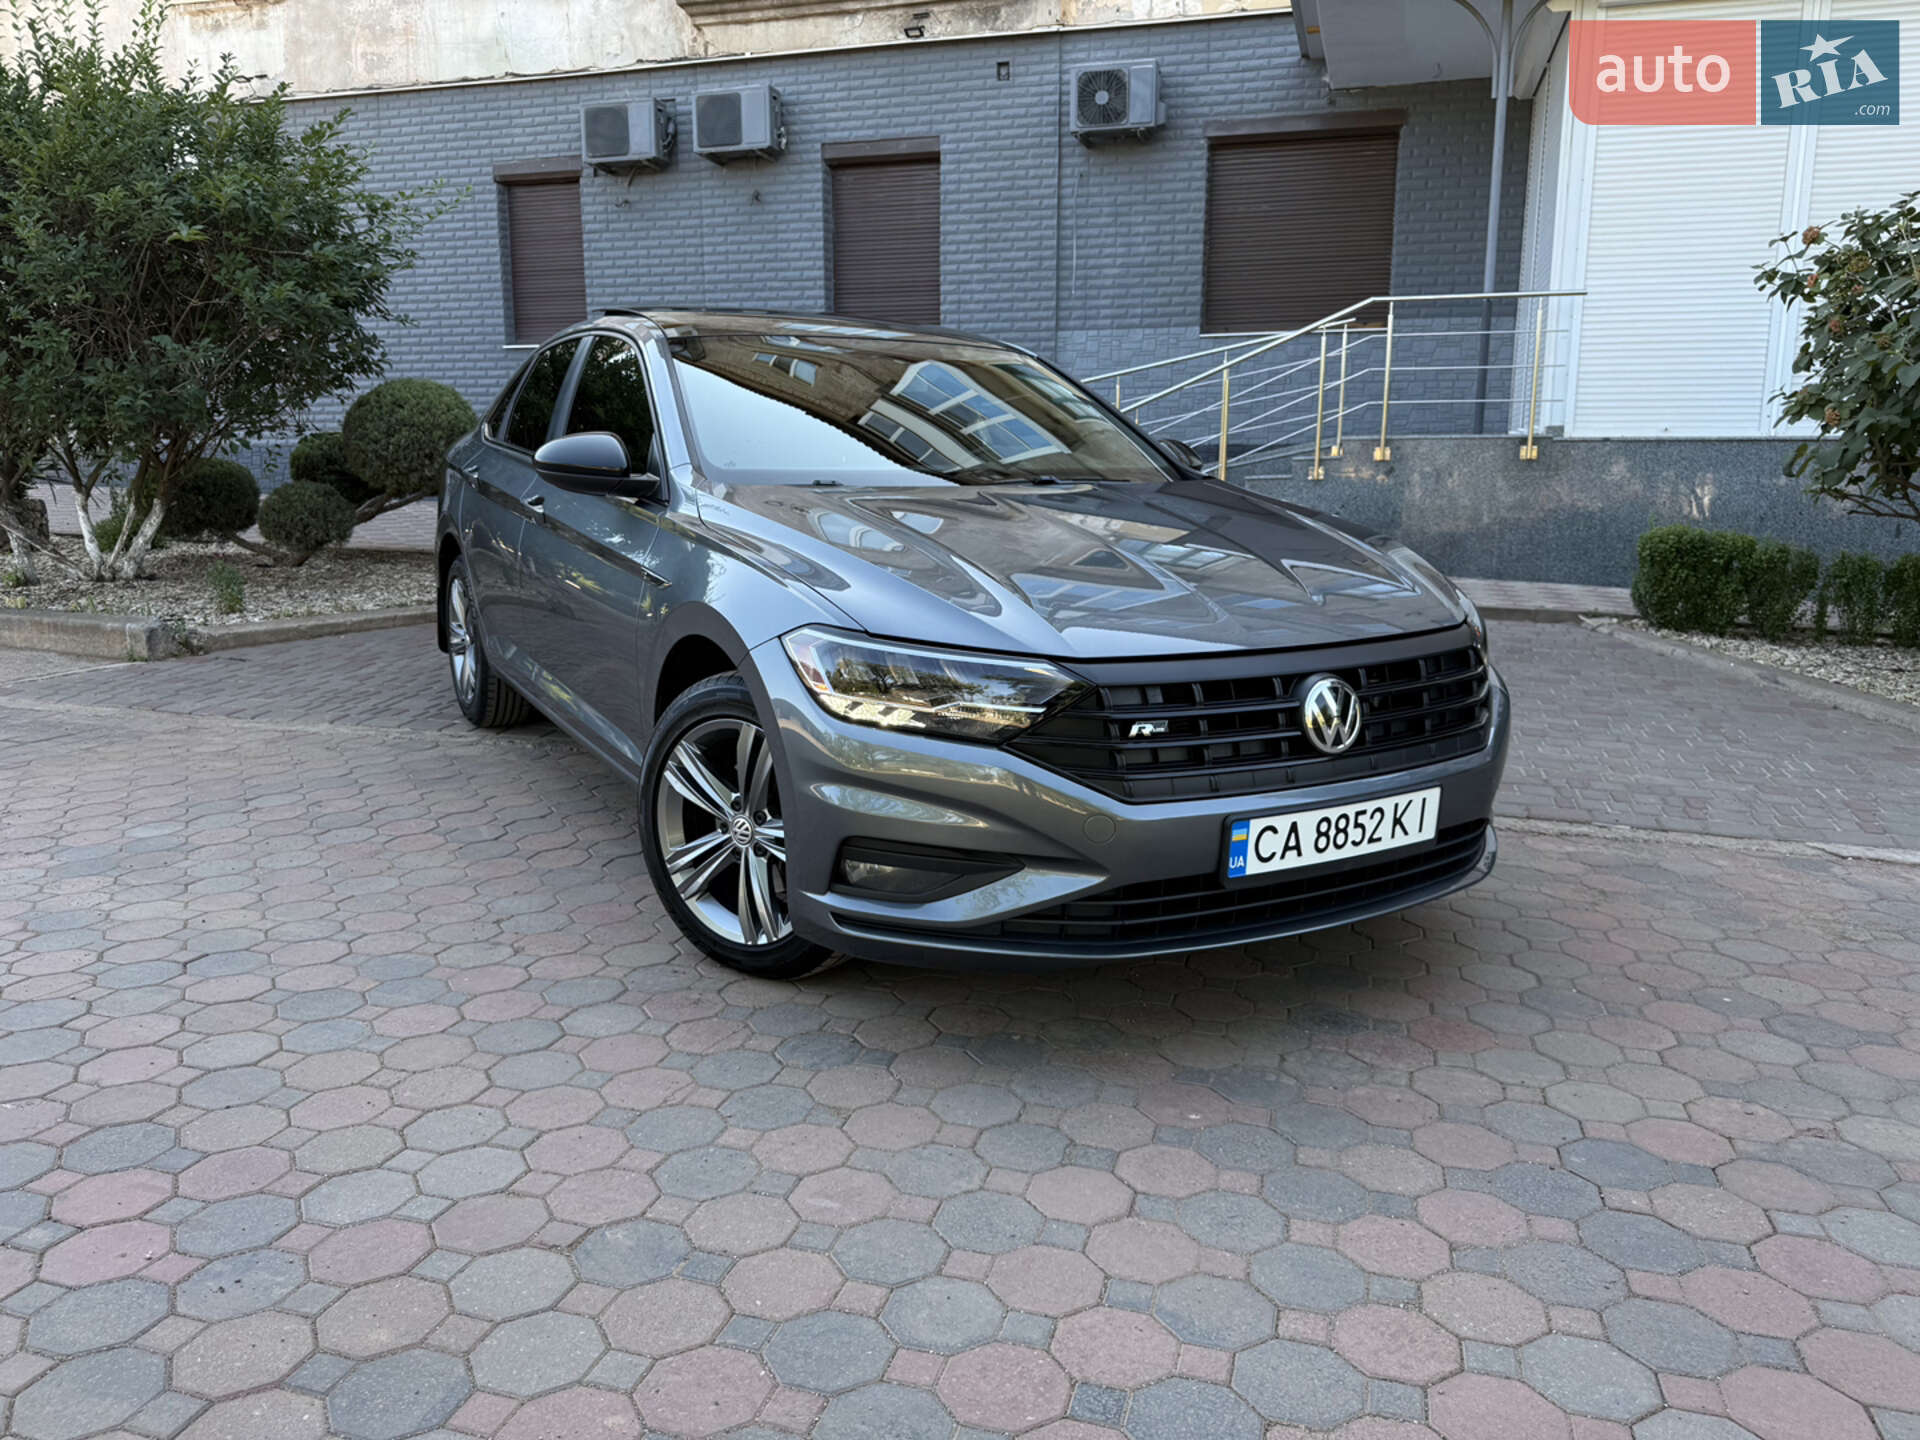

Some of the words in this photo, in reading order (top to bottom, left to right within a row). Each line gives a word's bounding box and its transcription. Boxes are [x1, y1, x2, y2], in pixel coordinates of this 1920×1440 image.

[1254, 821, 1302, 863] CA
[1314, 807, 1385, 854] 8852
[1391, 797, 1427, 839] KI
[1229, 855, 1245, 869] UA
